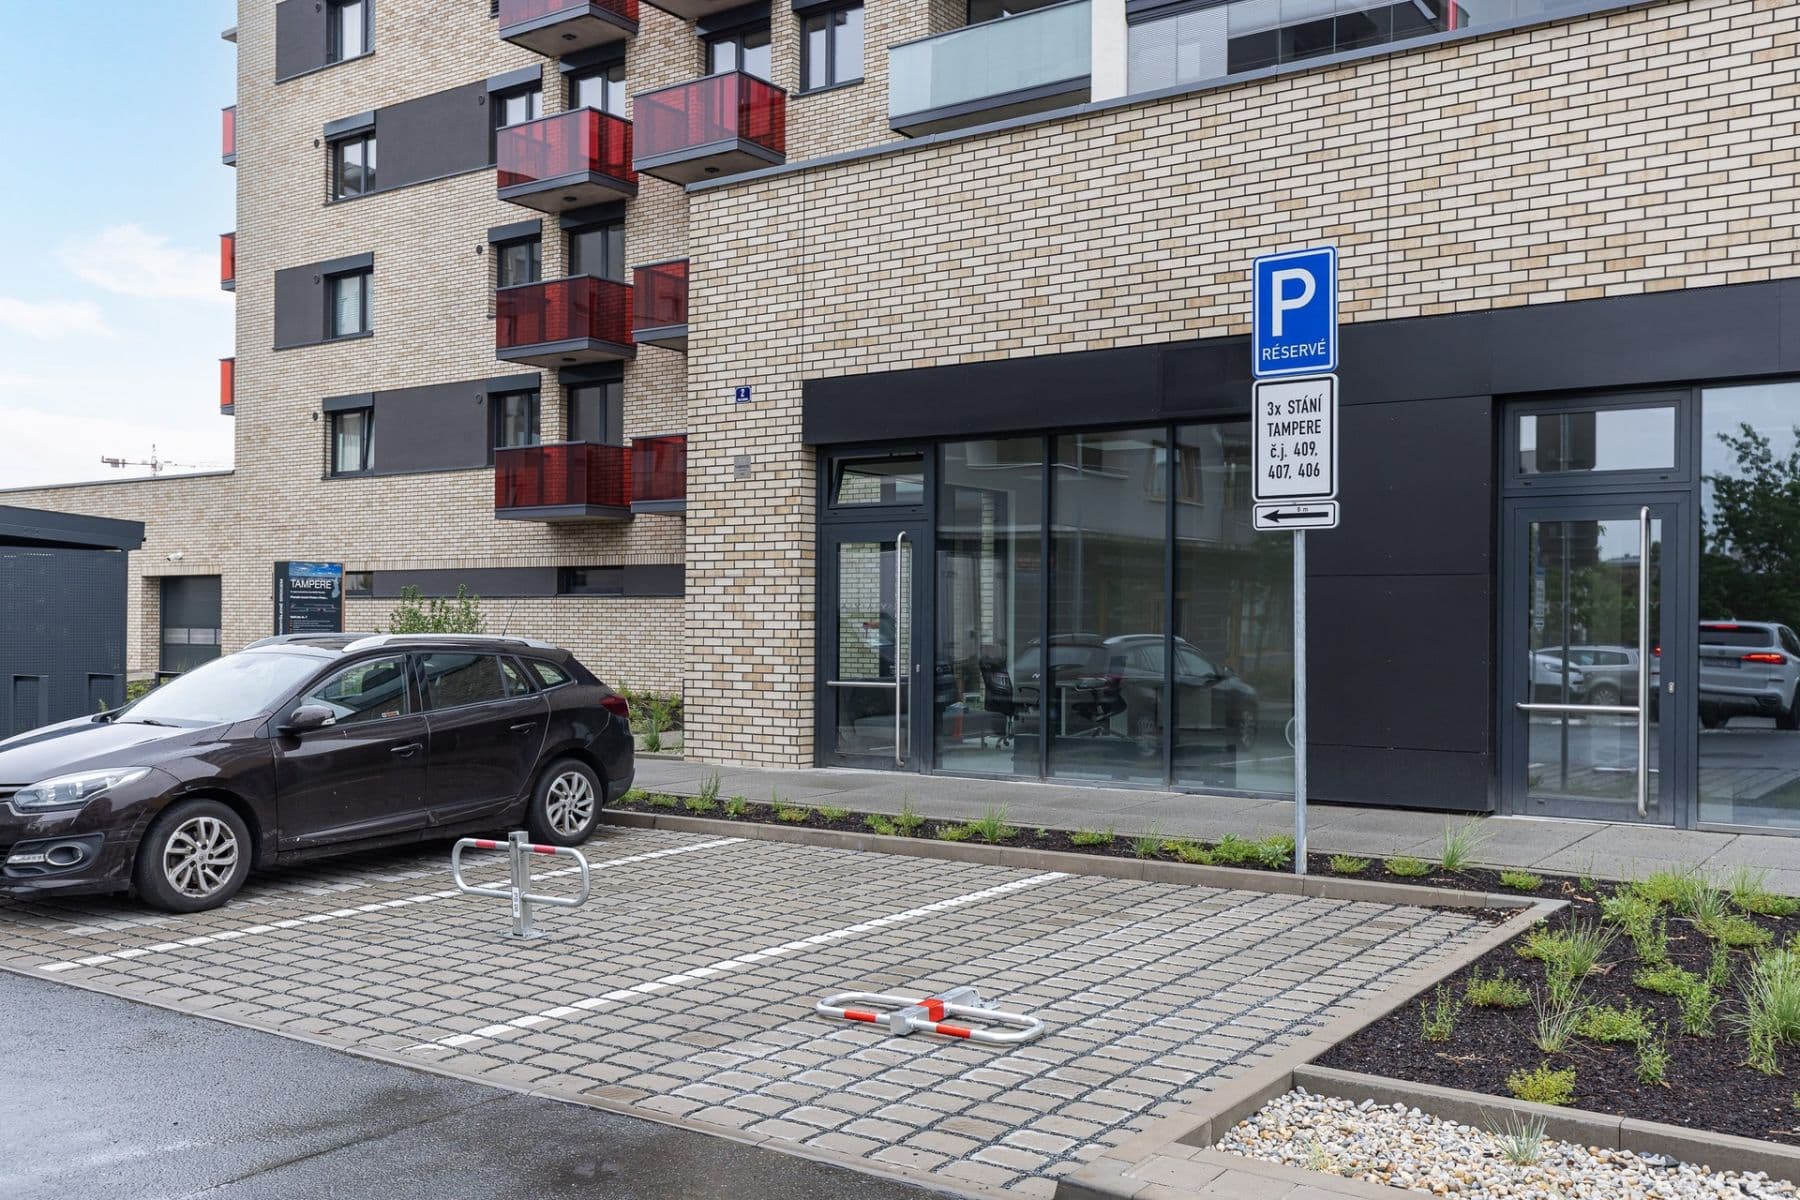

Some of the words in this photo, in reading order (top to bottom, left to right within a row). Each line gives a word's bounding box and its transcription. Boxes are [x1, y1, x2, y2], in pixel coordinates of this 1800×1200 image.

[1271, 268, 1316, 337] P
[1262, 339, 1327, 361] RÉSERVÉ
[1267, 401, 1282, 416] 3x
[1287, 394, 1323, 415] STÁNÍ
[1267, 419, 1322, 437] TAMPERE
[1270, 442, 1287, 461] č.j.
[1298, 462, 1320, 478] 406
[290, 579, 332, 589] TAMPERE
